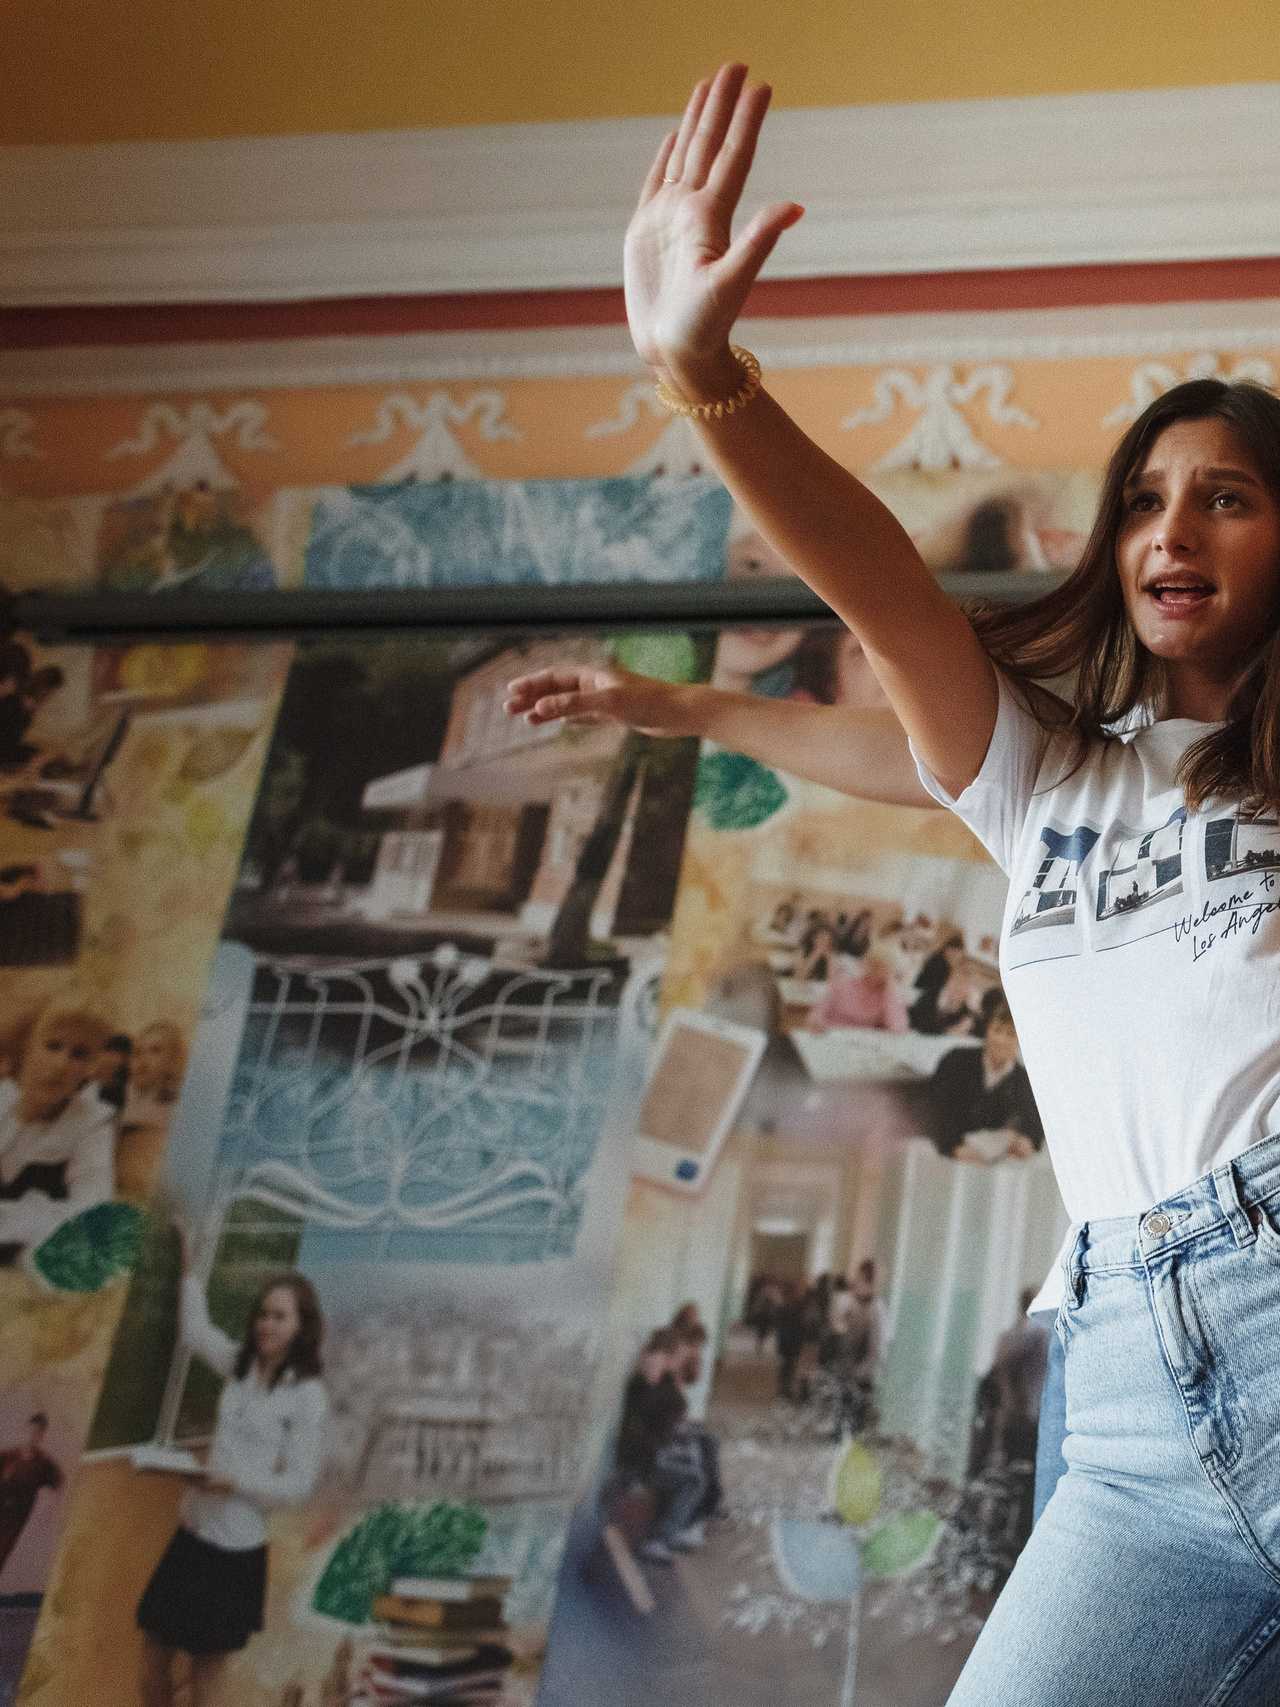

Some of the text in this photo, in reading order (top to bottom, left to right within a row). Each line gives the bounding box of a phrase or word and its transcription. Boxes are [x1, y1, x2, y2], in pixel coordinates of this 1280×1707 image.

[1174, 870, 1275, 942] Welcome to
[1192, 932, 1216, 963] Los
